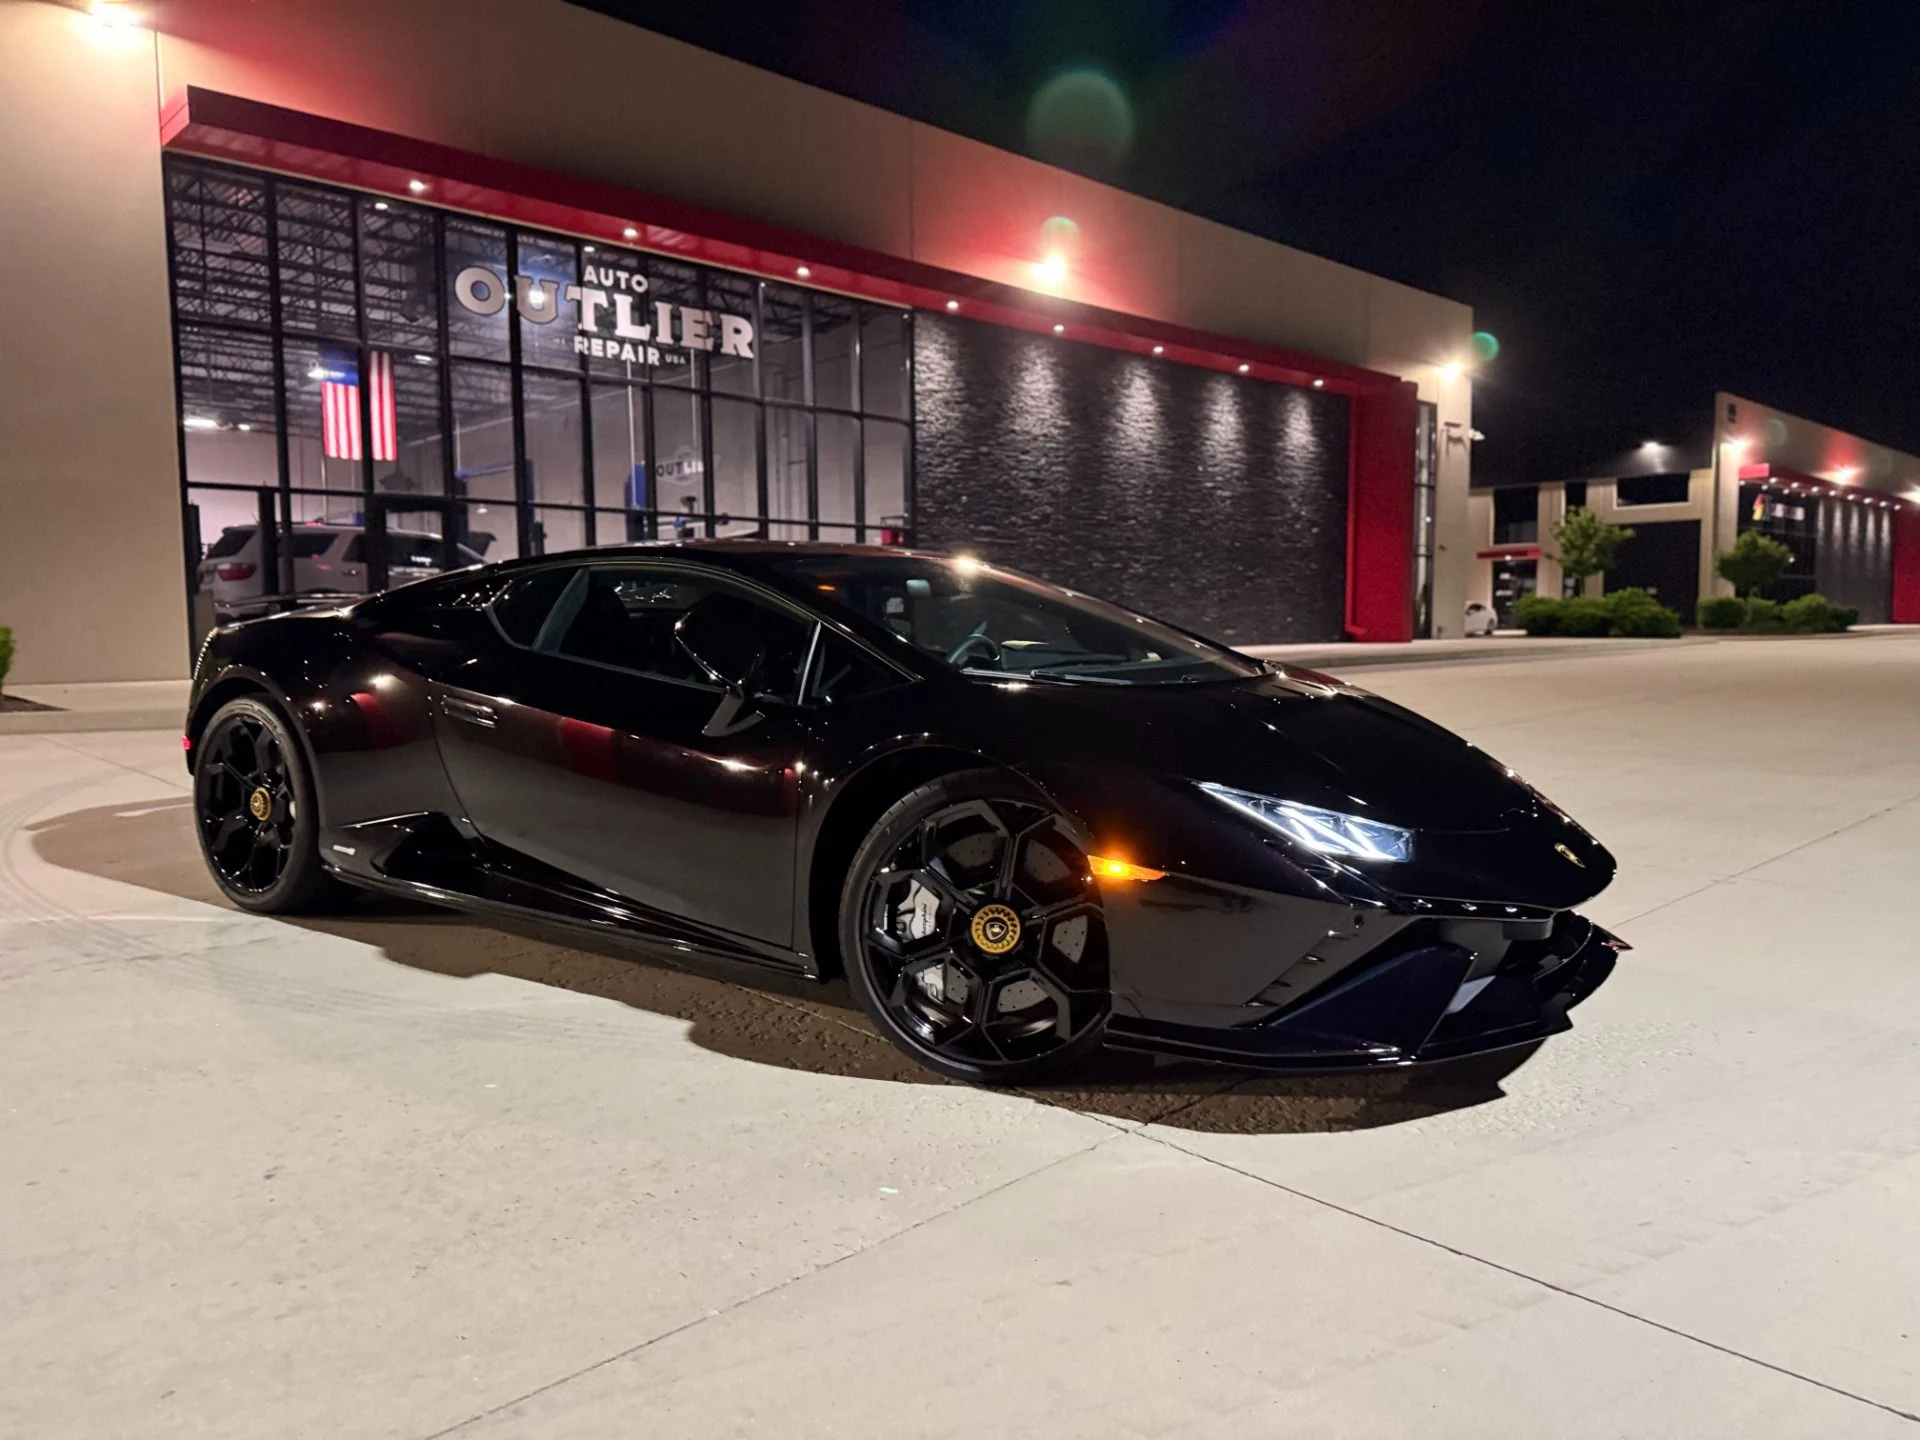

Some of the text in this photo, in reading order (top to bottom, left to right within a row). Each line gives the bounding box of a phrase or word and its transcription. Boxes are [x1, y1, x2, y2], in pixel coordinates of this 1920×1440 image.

[583, 265, 648, 293] AUTO
[455, 266, 755, 358] OUTLIER
[574, 335, 660, 366] REPAIR
